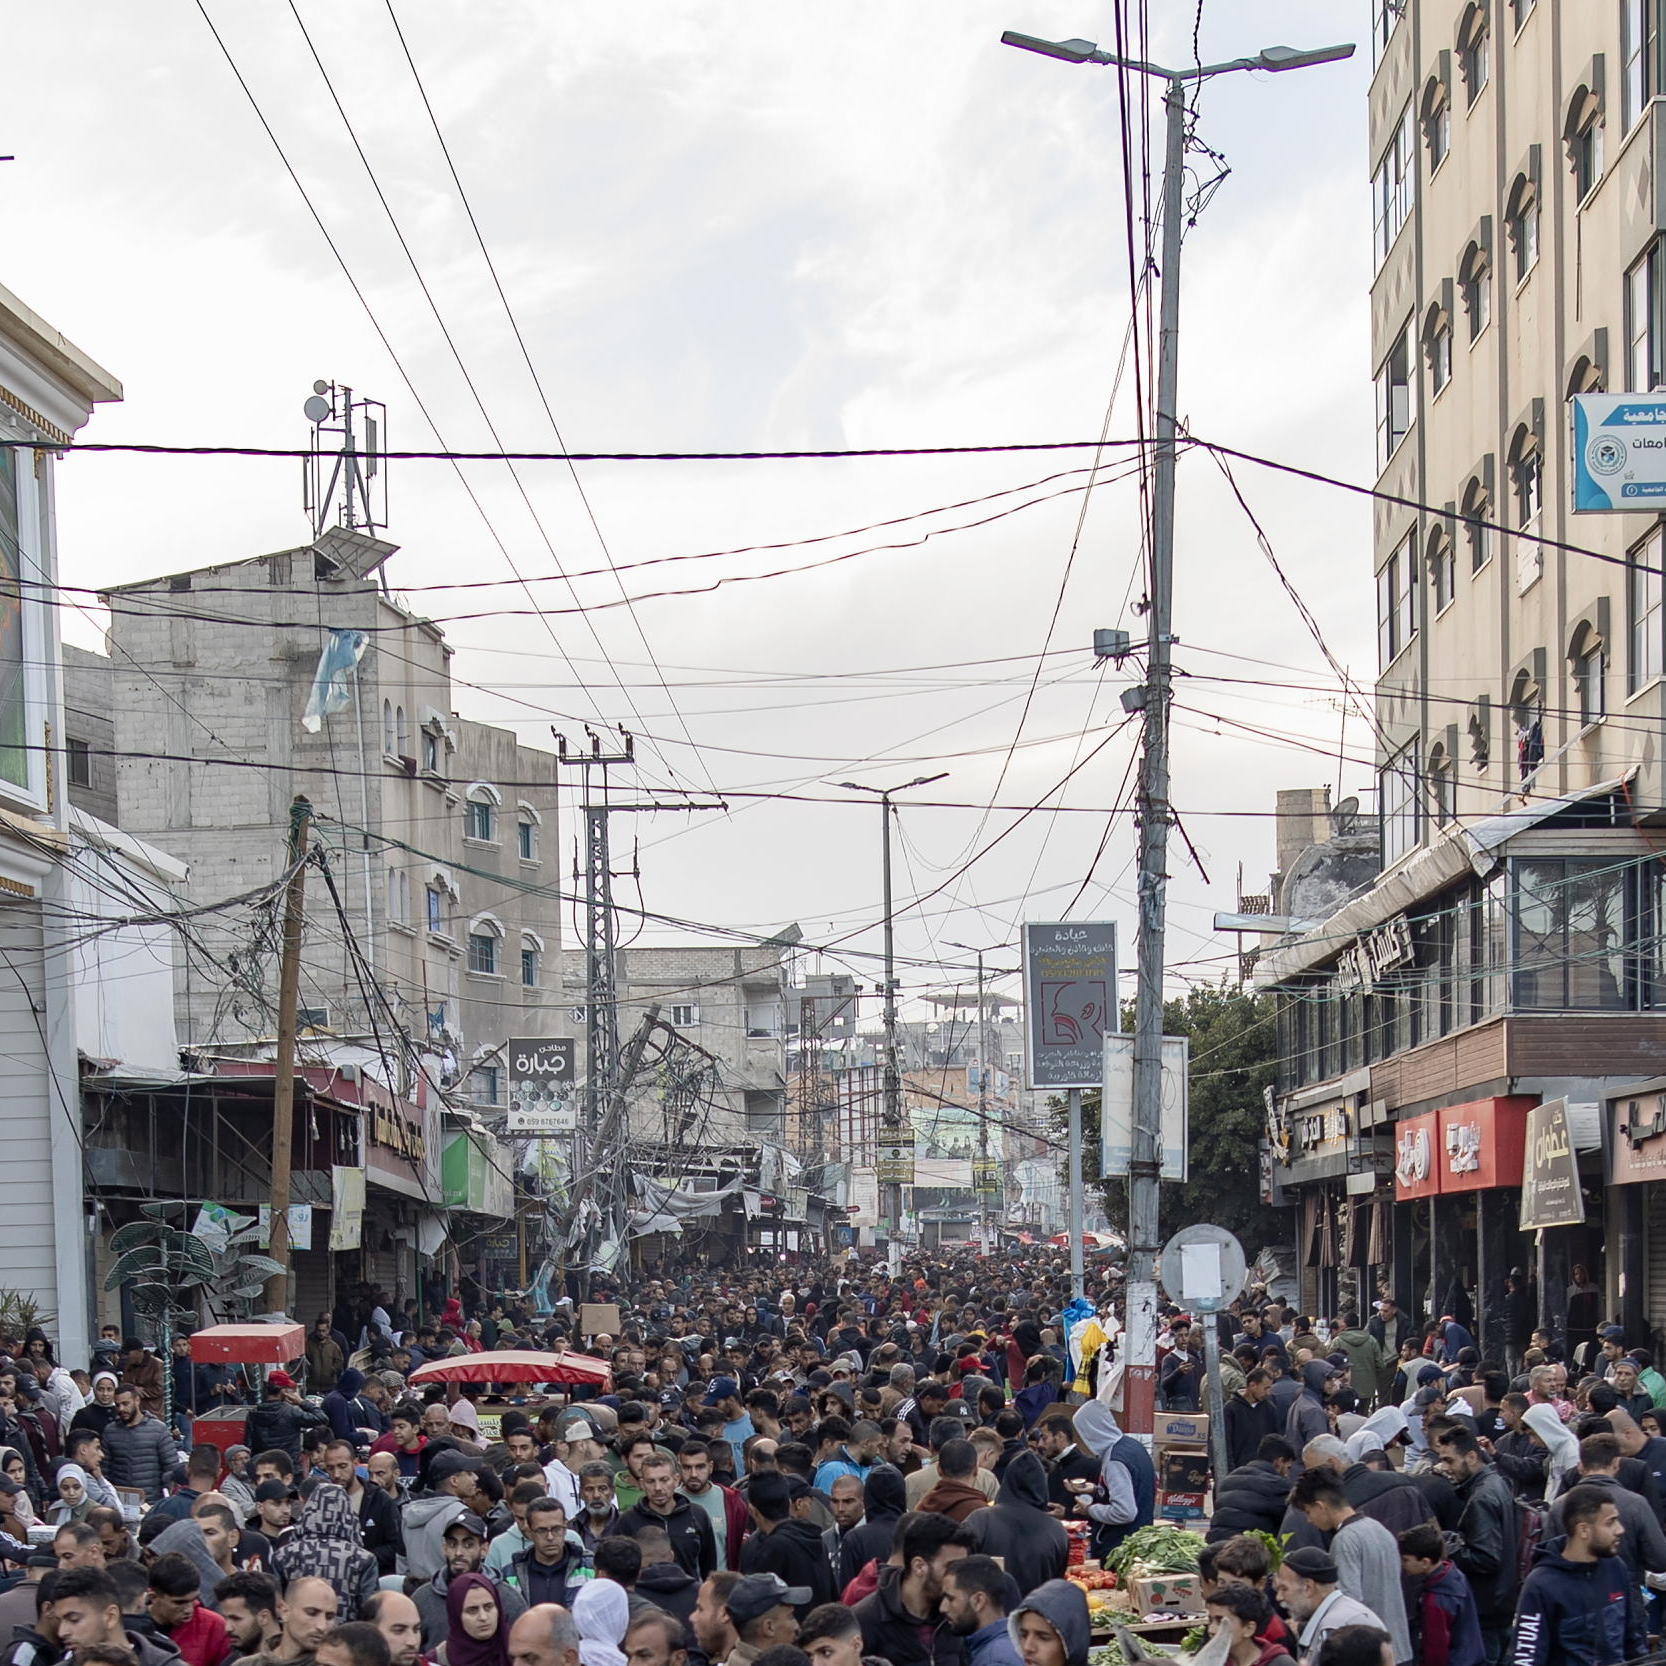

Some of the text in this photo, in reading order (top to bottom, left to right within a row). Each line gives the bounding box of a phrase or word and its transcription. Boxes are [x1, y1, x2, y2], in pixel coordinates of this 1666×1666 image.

[1055, 928, 1088, 943] عيادة
[539, 1043, 568, 1054] مطاحن
[516, 1053, 566, 1076] جبارة
